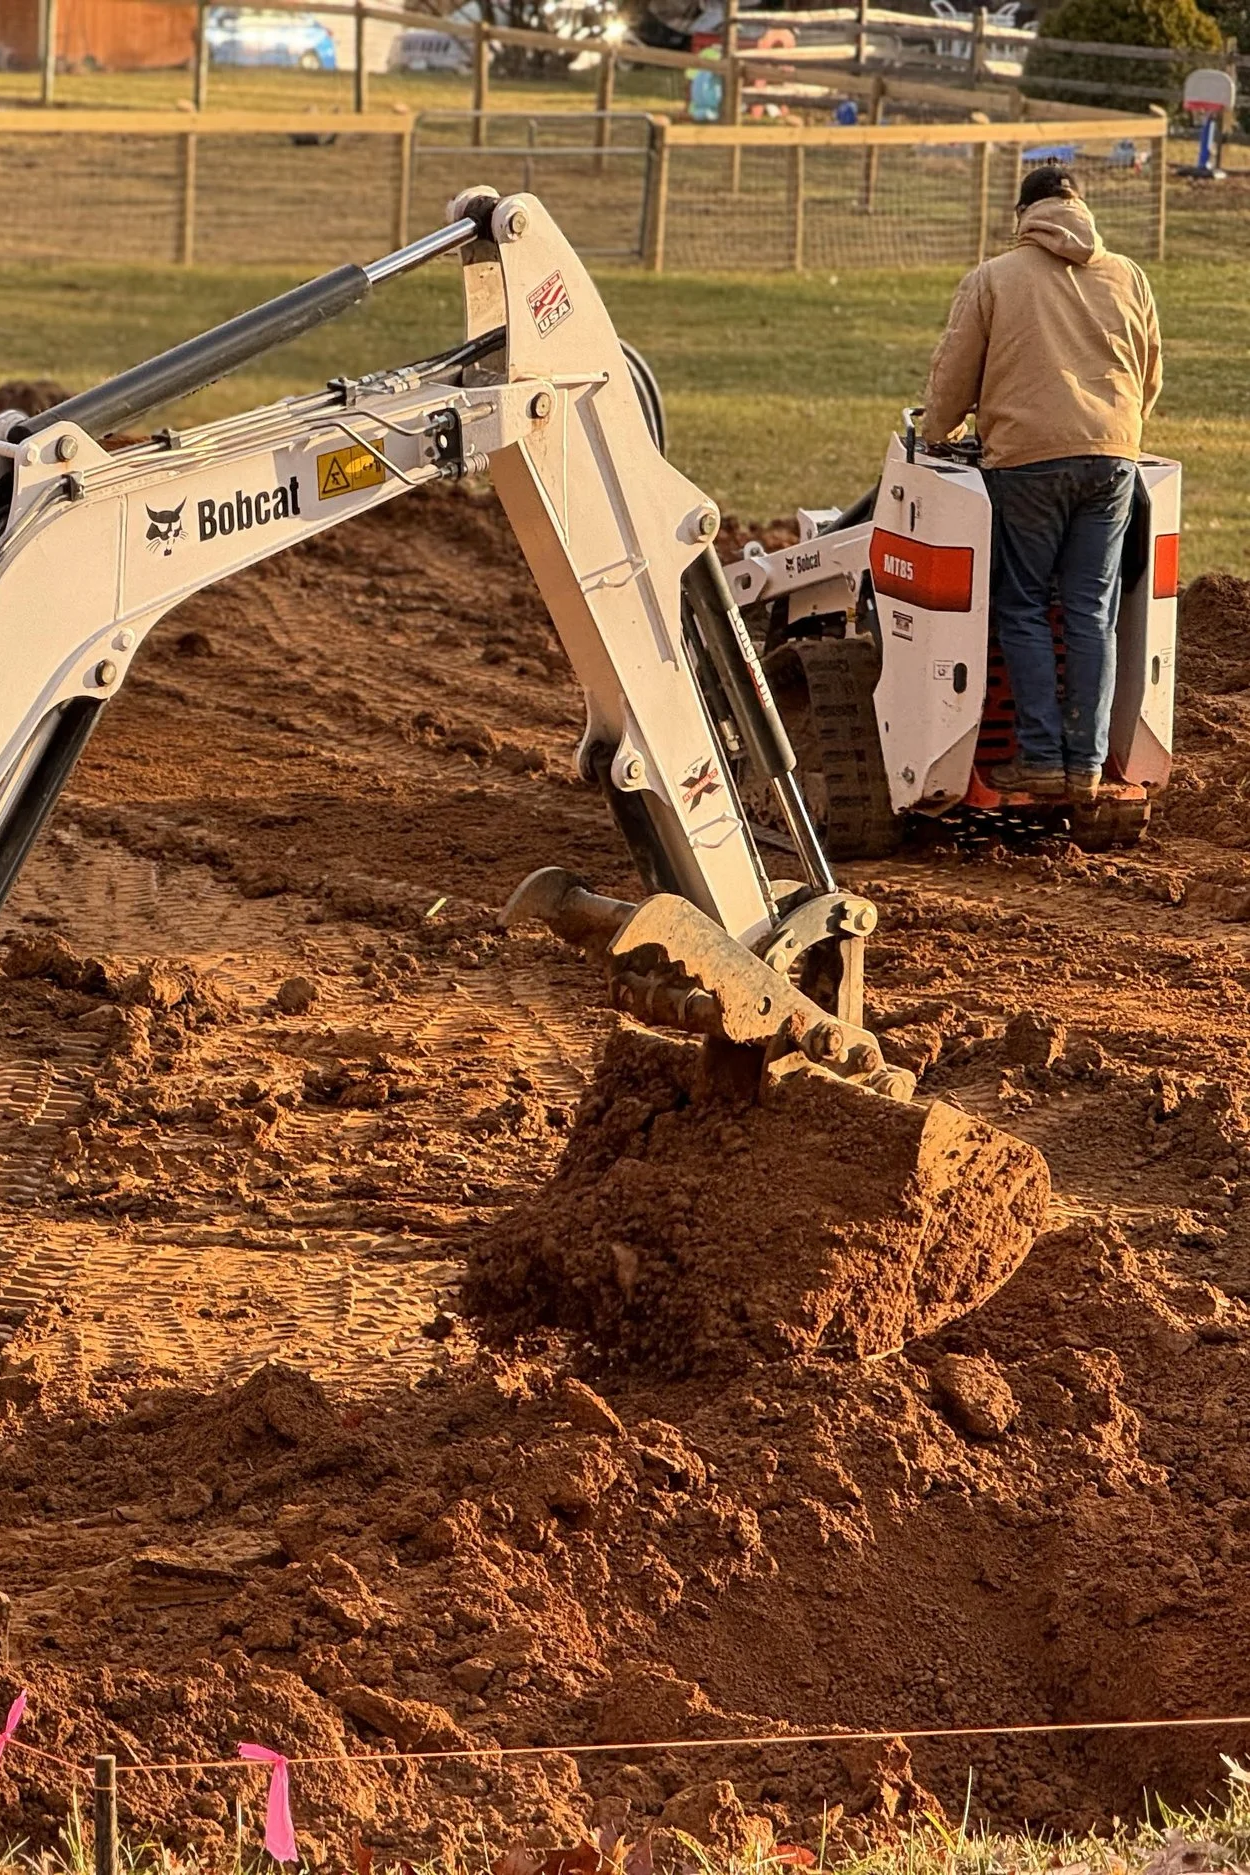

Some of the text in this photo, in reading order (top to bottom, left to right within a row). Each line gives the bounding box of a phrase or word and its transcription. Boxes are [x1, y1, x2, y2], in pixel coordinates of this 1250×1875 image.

[538, 301, 570, 332] USA
[197, 476, 301, 542] Bobcat
[796, 550, 821, 574] Bobcat
[883, 554, 914, 581] MT85
